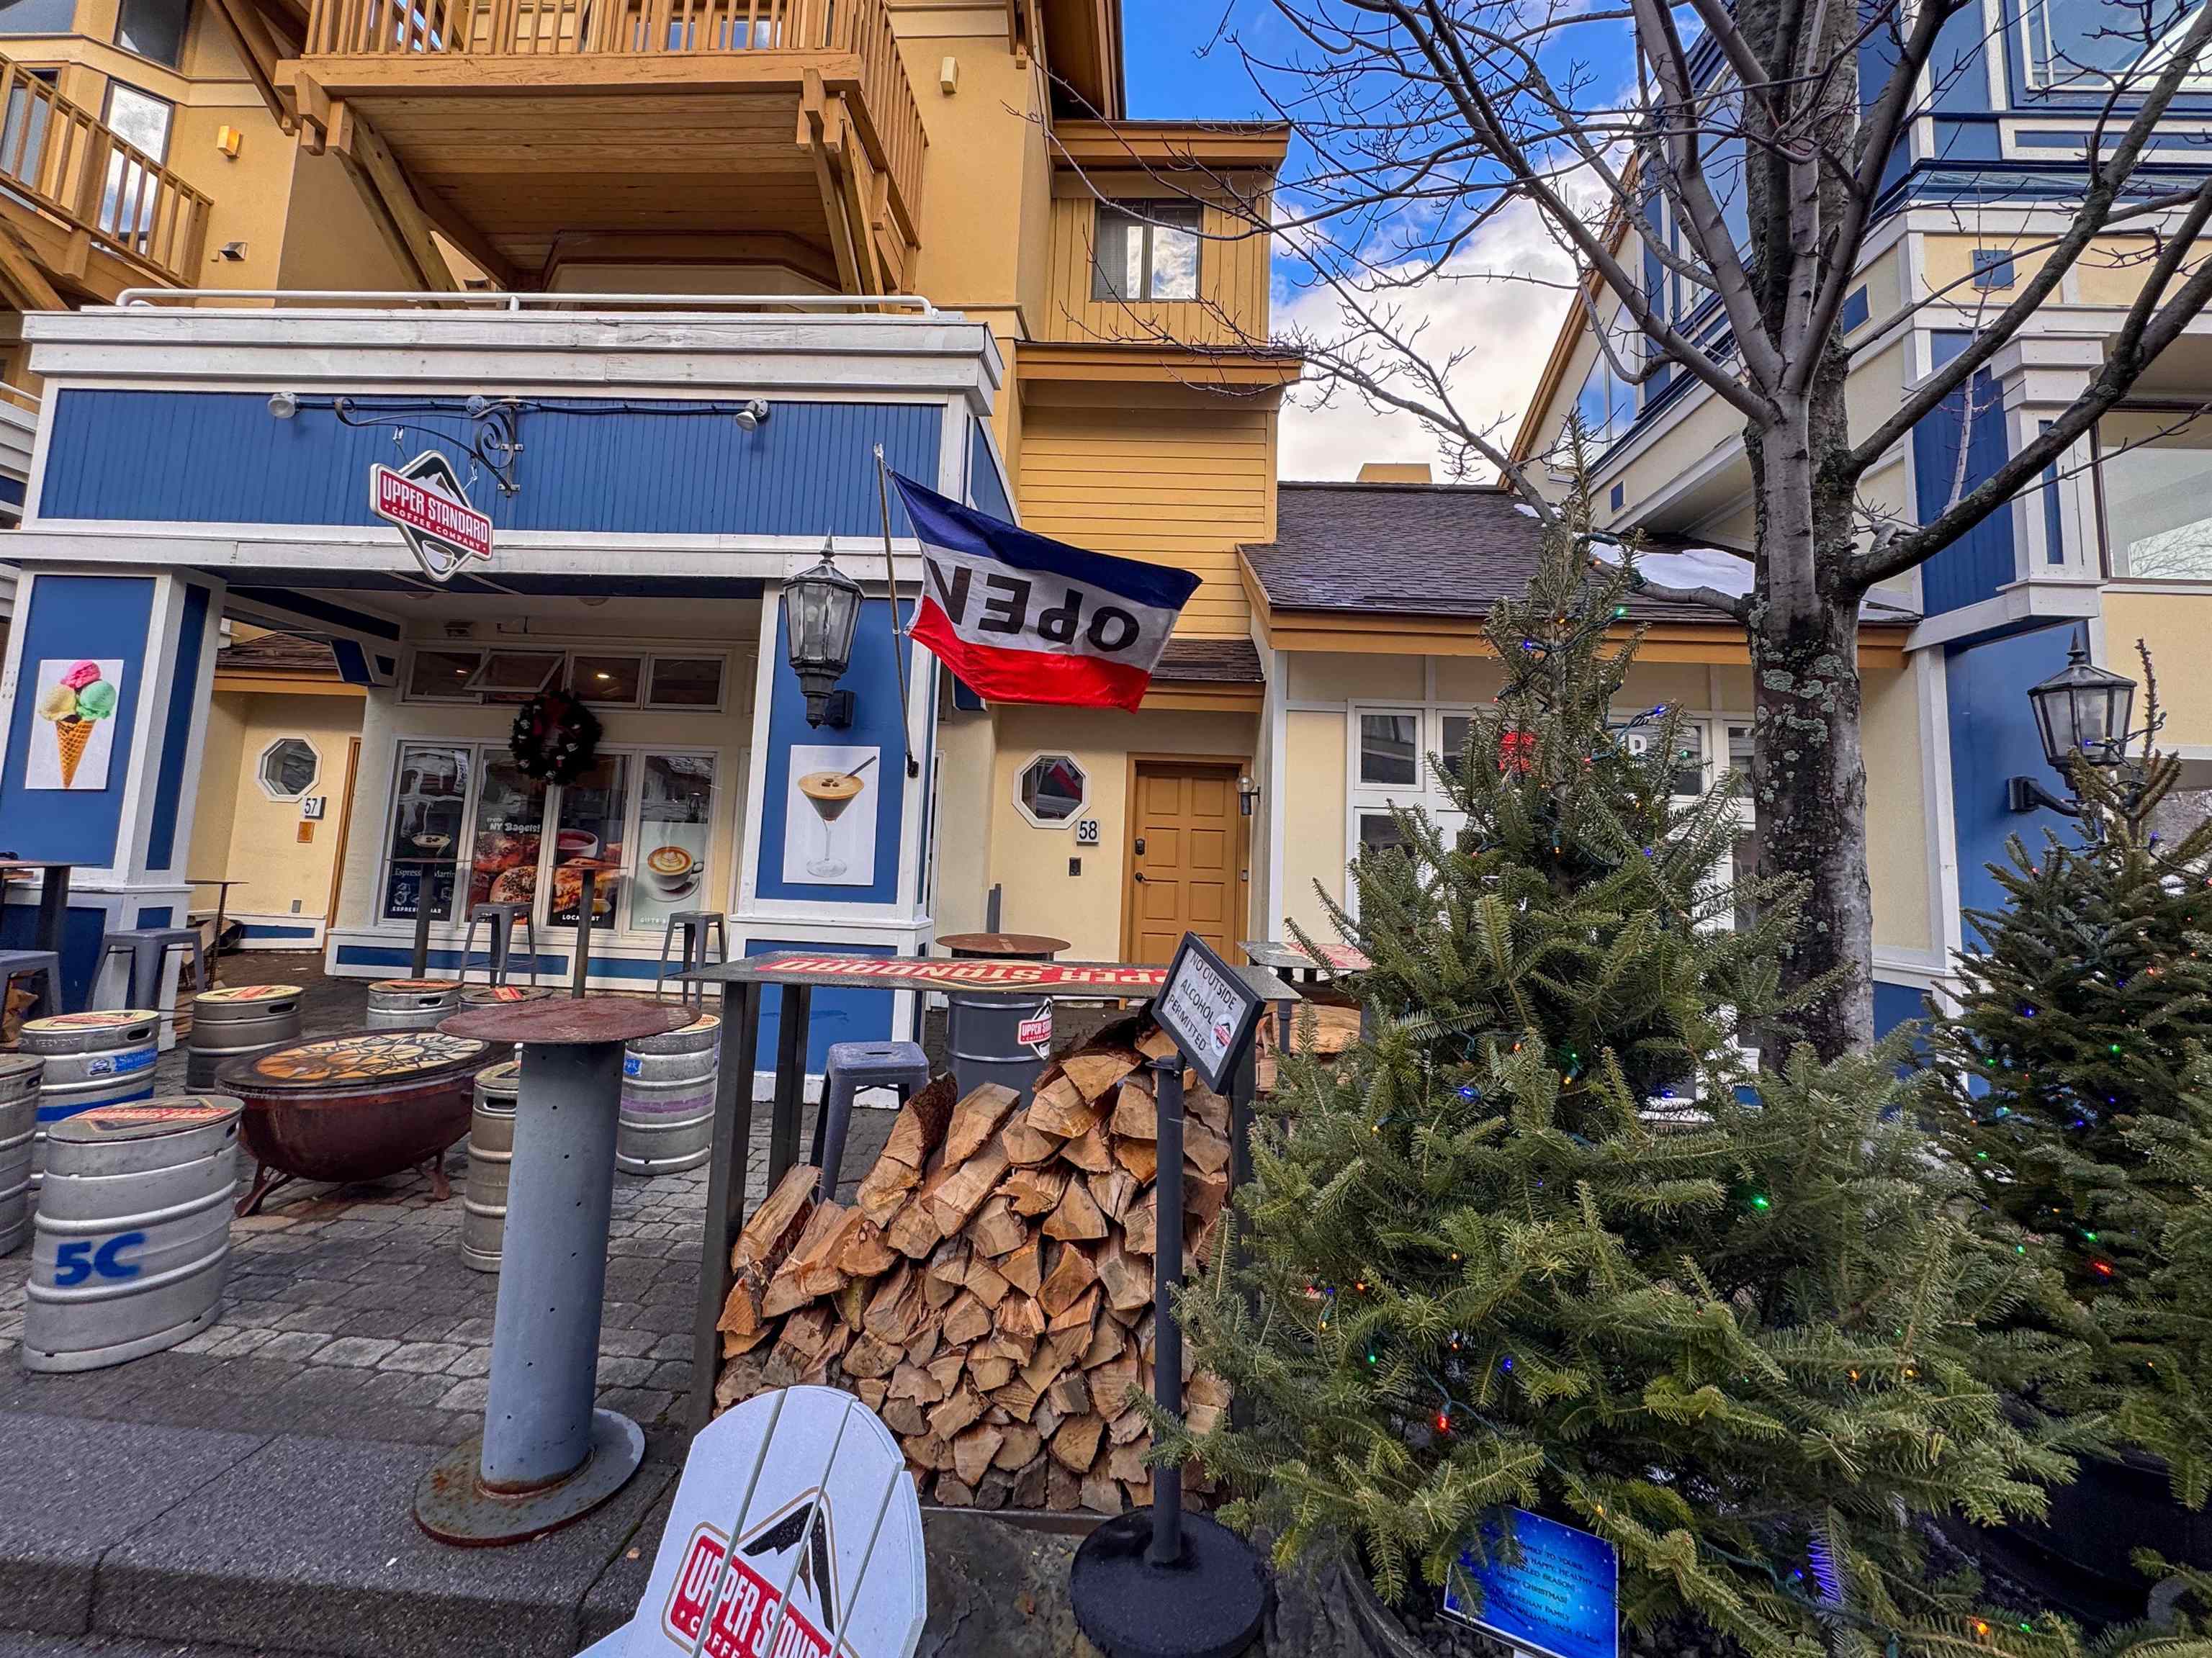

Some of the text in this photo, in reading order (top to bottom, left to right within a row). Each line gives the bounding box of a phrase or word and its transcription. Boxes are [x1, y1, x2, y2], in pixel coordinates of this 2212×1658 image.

[382, 474, 488, 543] UPPER STANDARD
[392, 506, 480, 550] COFFEE COMPANY
[925, 557, 1140, 652] OPEN
[305, 798, 318, 814] 57
[505, 822, 541, 834] Bagels!
[1079, 821, 1097, 839] 58
[395, 868, 421, 878] Espress
[770, 960, 1043, 981] STANDARD
[1190, 952, 1203, 970] NO
[1202, 967, 1236, 1010] OUTSIDE
[1168, 994, 1207, 1050] PERMITTED
[1181, 979, 1215, 1024] ALCOHOL
[1022, 1023, 1042, 1037] UPPER
[53, 1232, 147, 1287] 5C
[685, 1545, 760, 1643] UPPER
